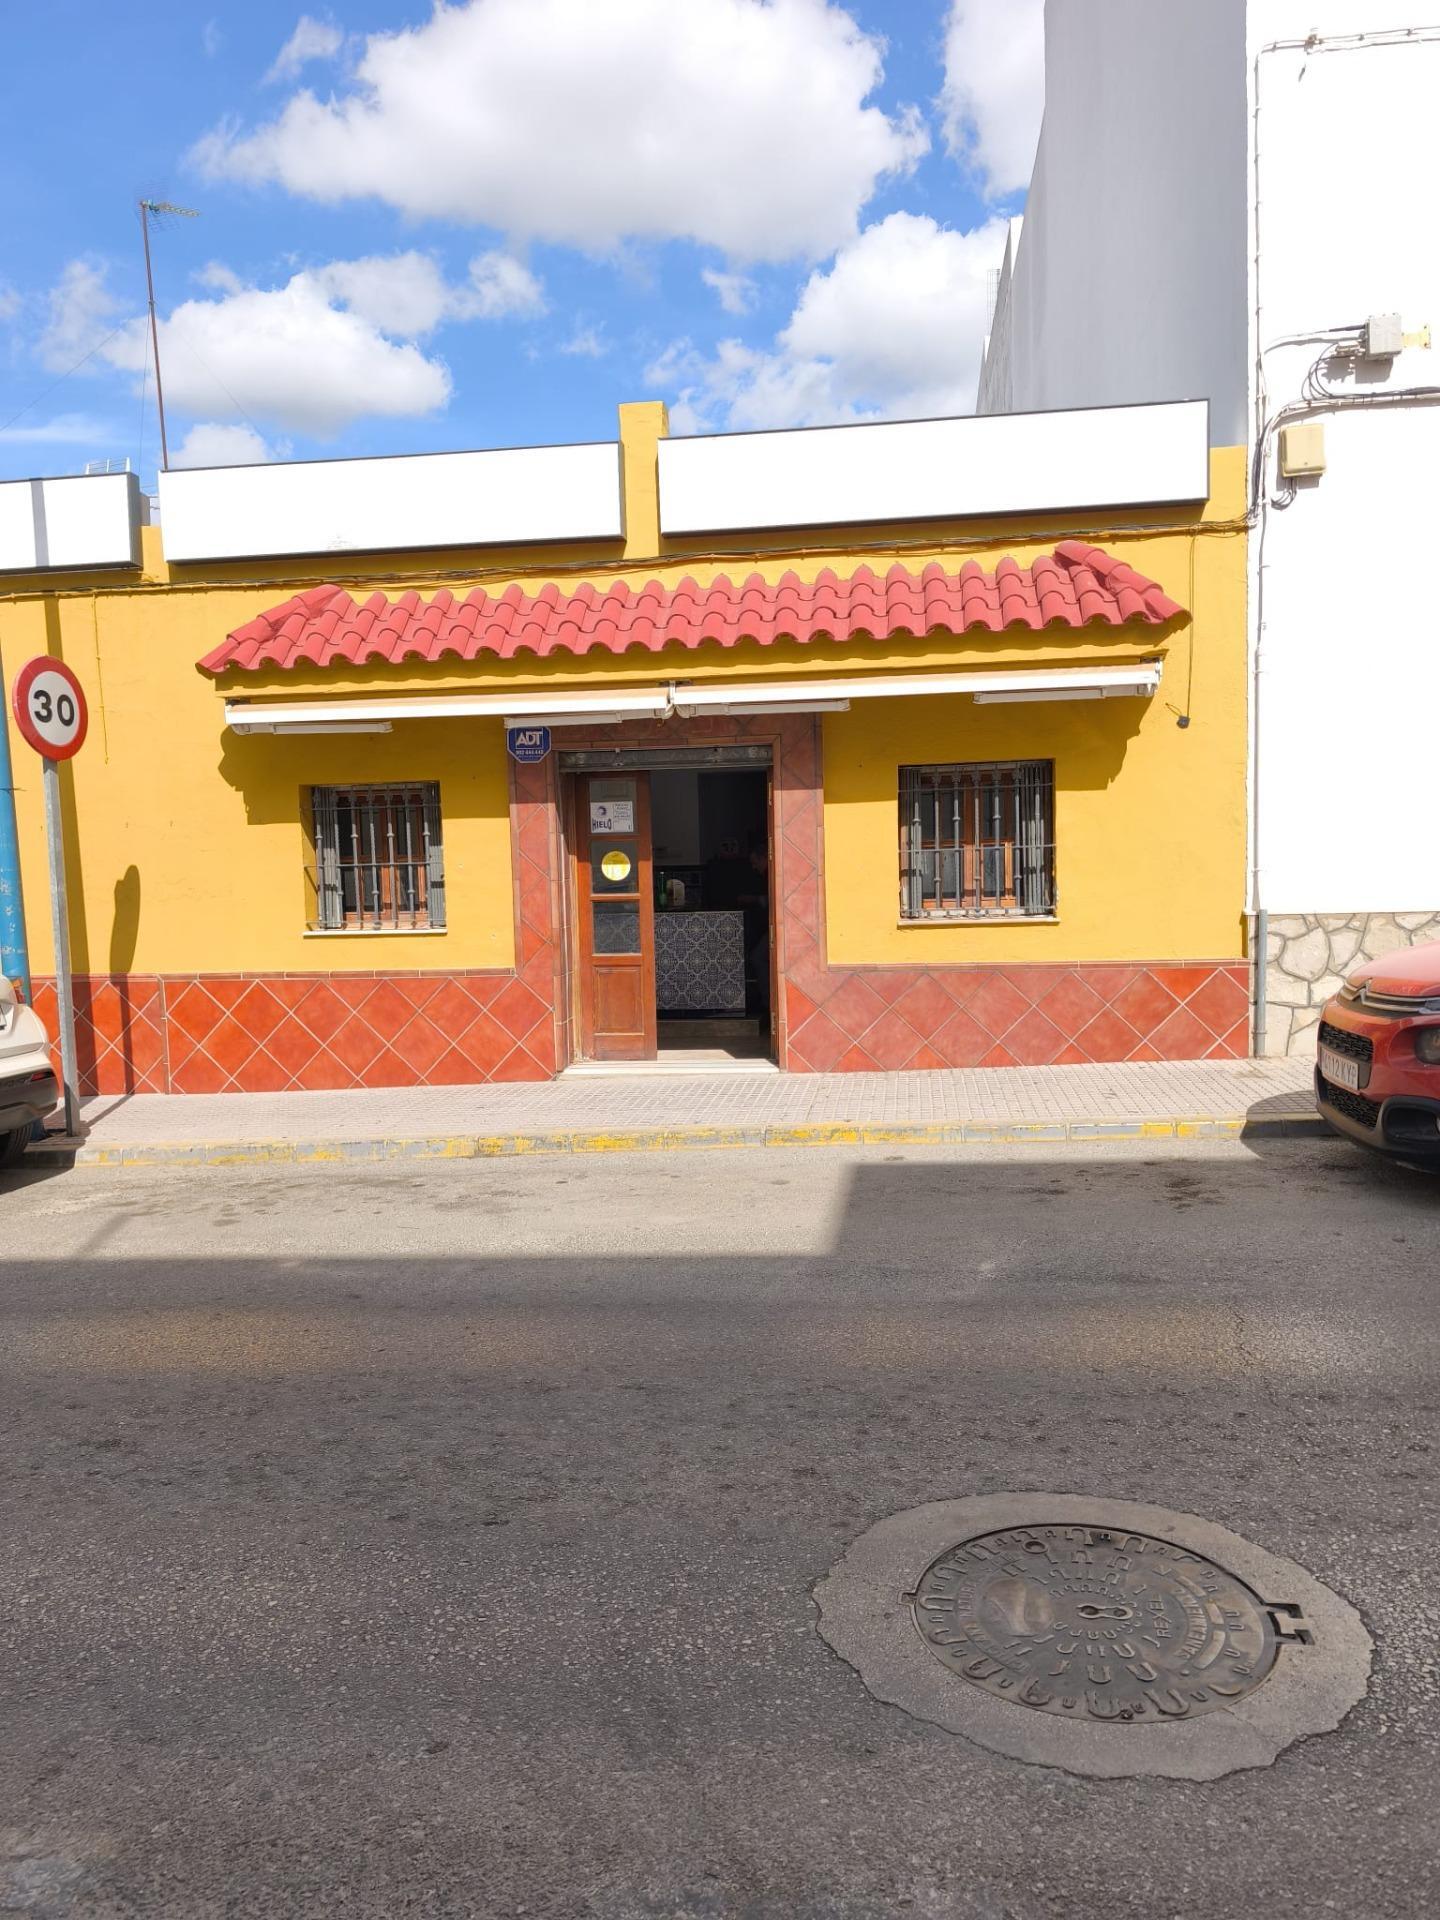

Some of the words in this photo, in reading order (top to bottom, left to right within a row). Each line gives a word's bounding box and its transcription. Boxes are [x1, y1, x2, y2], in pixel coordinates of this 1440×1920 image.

[33, 689, 75, 727] 30
[516, 731, 543, 746] ADT
[592, 818, 612, 831] HIELO
[1147, 1592, 1172, 1638] REXEL
